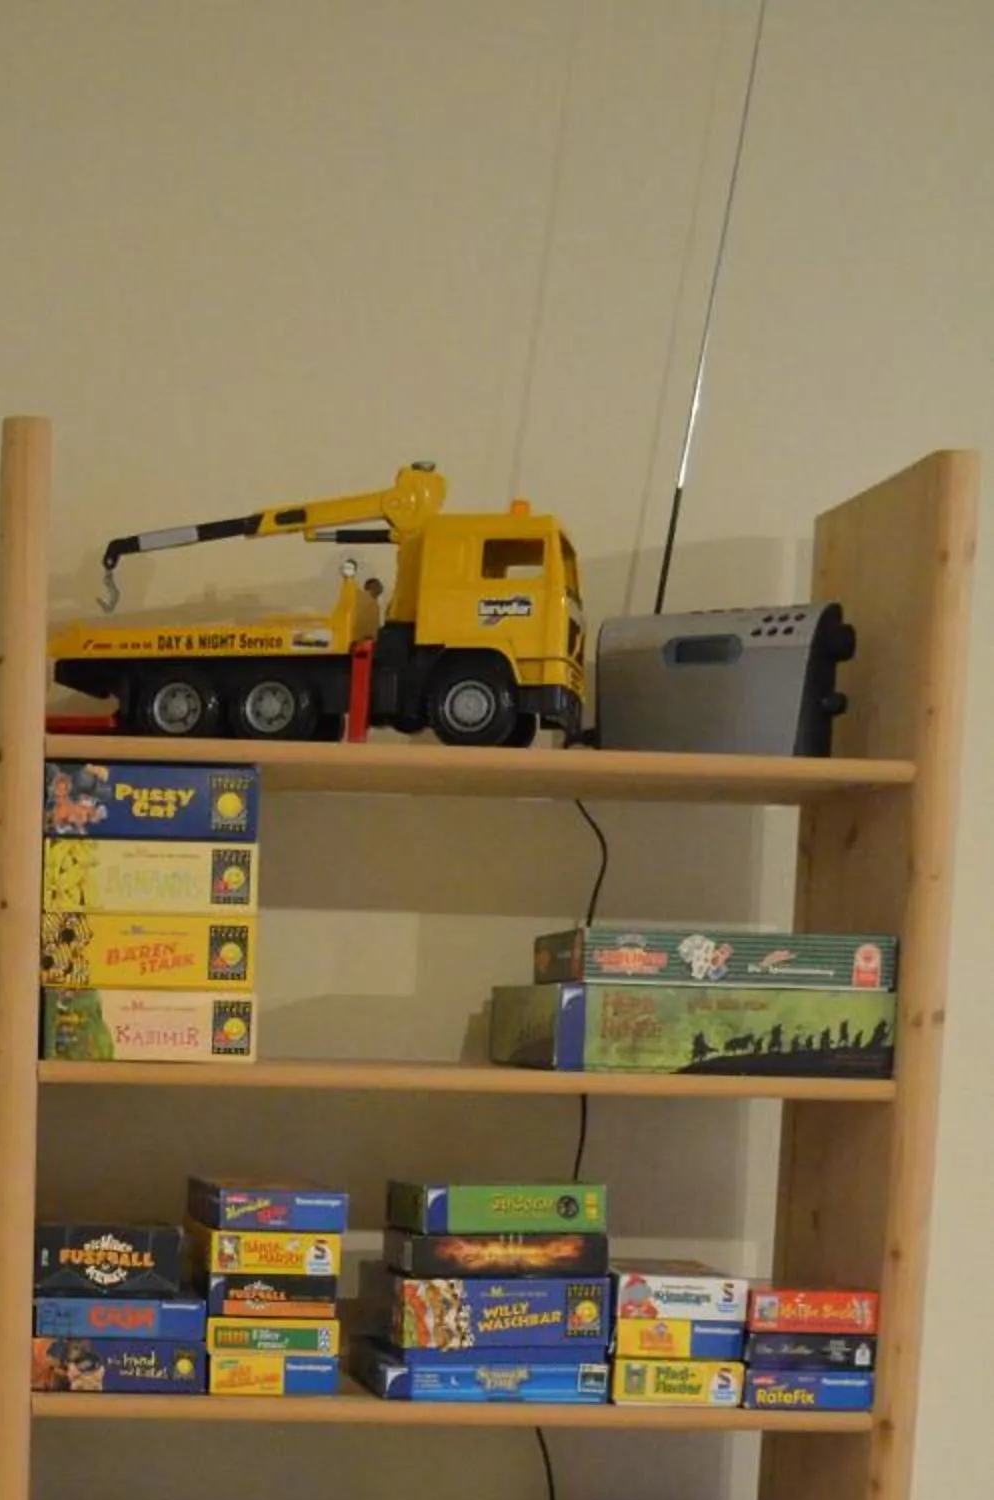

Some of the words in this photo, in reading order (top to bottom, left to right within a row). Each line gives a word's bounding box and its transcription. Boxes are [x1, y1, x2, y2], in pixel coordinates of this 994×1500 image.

[157, 635, 181, 650] DAY
[199, 634, 237, 649] NIGHT
[239, 632, 283, 648] Service
[114, 783, 196, 806] Pussy
[131, 801, 178, 818] Cat
[483, 1302, 529, 1319] WILLY
